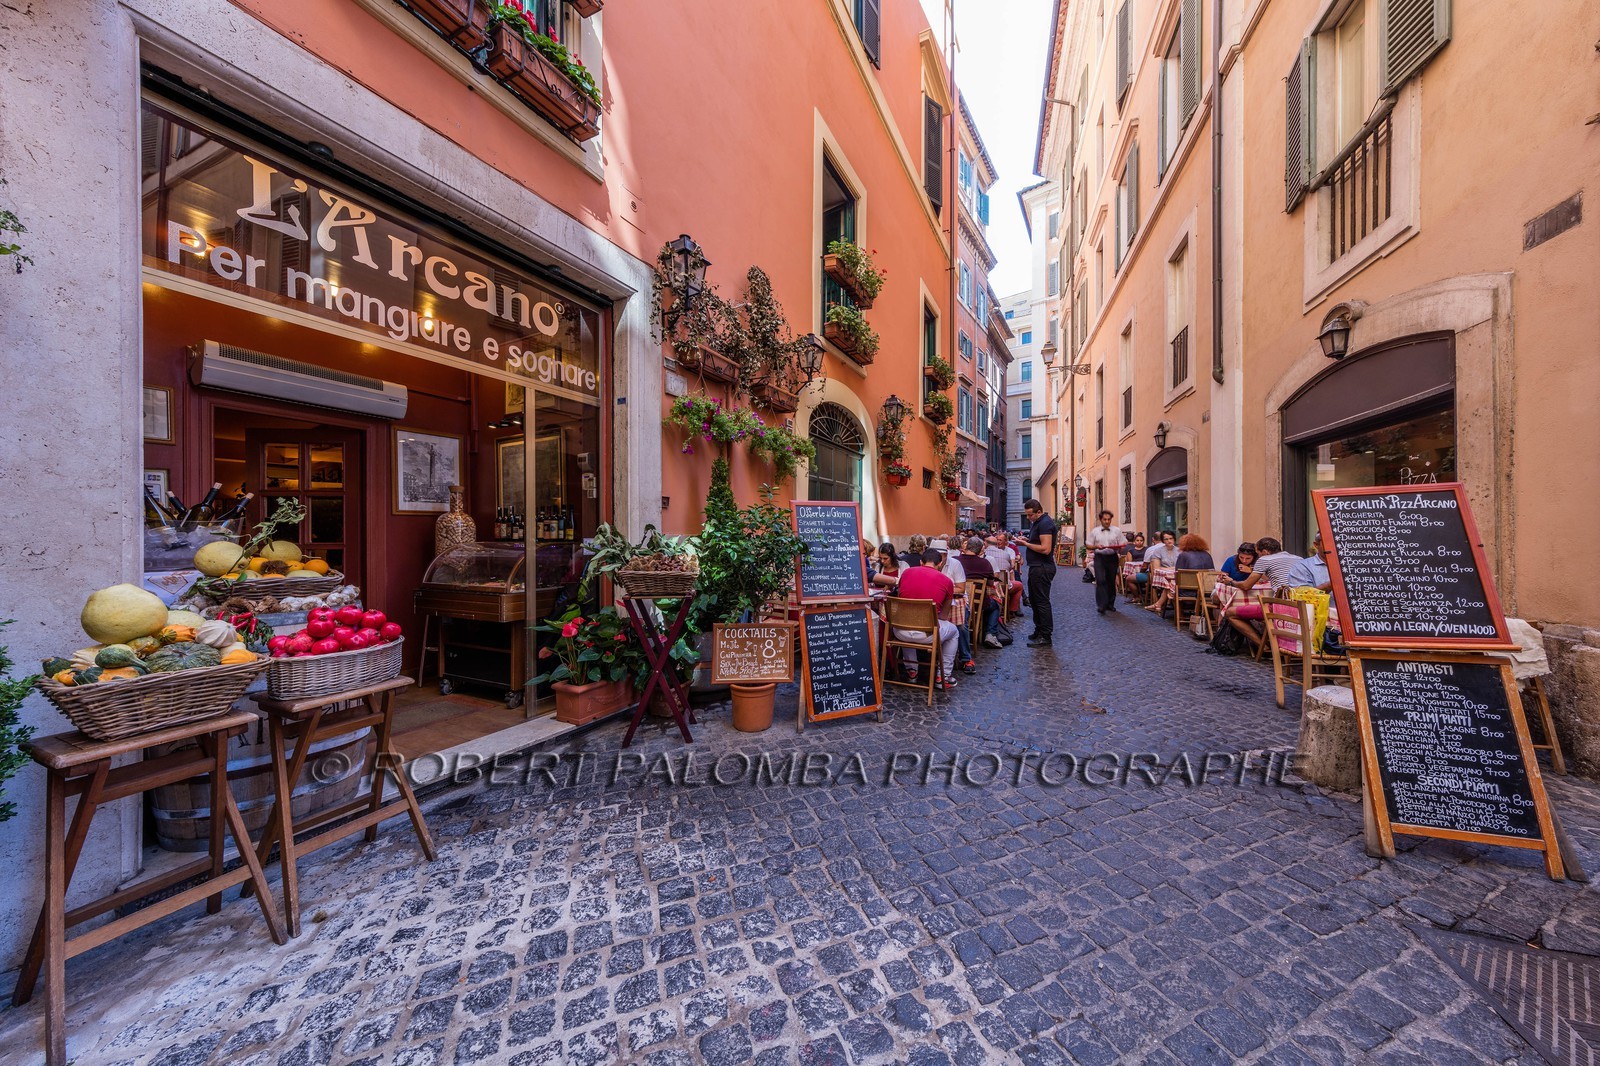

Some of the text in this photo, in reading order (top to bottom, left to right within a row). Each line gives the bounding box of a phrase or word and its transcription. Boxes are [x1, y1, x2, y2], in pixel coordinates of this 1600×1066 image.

[167, 220, 596, 391] Per mangiare e sognare
[1326, 496, 1387, 510] SPECIALITÀ
[1335, 518, 1380, 526] PROSCIUTTO
[1400, 548, 1434, 556] RUCOLA
[1346, 557, 1392, 566] BOSCAIOLA
[1348, 566, 1370, 574] FIORI
[1381, 566, 1411, 574] ZUCCA
[1422, 564, 1447, 574] ALICI
[1394, 574, 1430, 582] PACHINO
[1355, 584, 1362, 592] 4
[1363, 584, 1401, 592] STAGIONI
[1358, 605, 1390, 613] PATATE
[1400, 599, 1453, 607] SCAMORZA
[1362, 612, 1412, 620] TRICOLORE
[725, 628, 776, 638] COCKTAILS
[1356, 621, 1391, 634] FORNO
[1394, 622, 1402, 631] A
[1468, 624, 1496, 635] WOOD
[1372, 670, 1411, 680] CAPRESE
[1396, 662, 1453, 676] ANTIPASTI
[1401, 680, 1433, 689] BUFALA
[1376, 694, 1418, 704] BRESAOLA
[1404, 690, 1440, 699] MELONE
[1378, 701, 1414, 710] TAGLIERE
[1428, 705, 1470, 716] AFFETTATI
[1404, 711, 1472, 727] PRIMI PIATTI
[1385, 725, 1436, 738] CARBONARA
[1386, 733, 1439, 745] AMATRICIANA
[1387, 740, 1438, 750] FETTUCCINE
[1448, 746, 1493, 757] POMODORO
[1388, 746, 1424, 756] GNOCCHI
[1436, 751, 1476, 762] POMODORO
[1390, 753, 1419, 763] PESTO
[1392, 760, 1425, 769] RISOTTO
[1428, 764, 1482, 776] VEGETARIANO
[1393, 767, 1426, 776] RISOTTO
[1428, 770, 1459, 780] SCAMPI
[1418, 775, 1499, 795] SECONDI PIATTI
[1396, 782, 1450, 794] MELANZANA
[1463, 790, 1511, 803] PARMIGIANA
[1400, 788, 1437, 800] POLPETTE
[1450, 796, 1495, 810] POMODORO
[1400, 796, 1426, 805] POLLO
[1448, 804, 1484, 814] GRIGLIA
[1402, 803, 1435, 812] FETTINE
[1446, 810, 1475, 820] MANZO
[1404, 809, 1455, 822] STRACCETTI
[1468, 819, 1499, 830] MANZO
[1404, 816, 1450, 827] COTOLETTA
